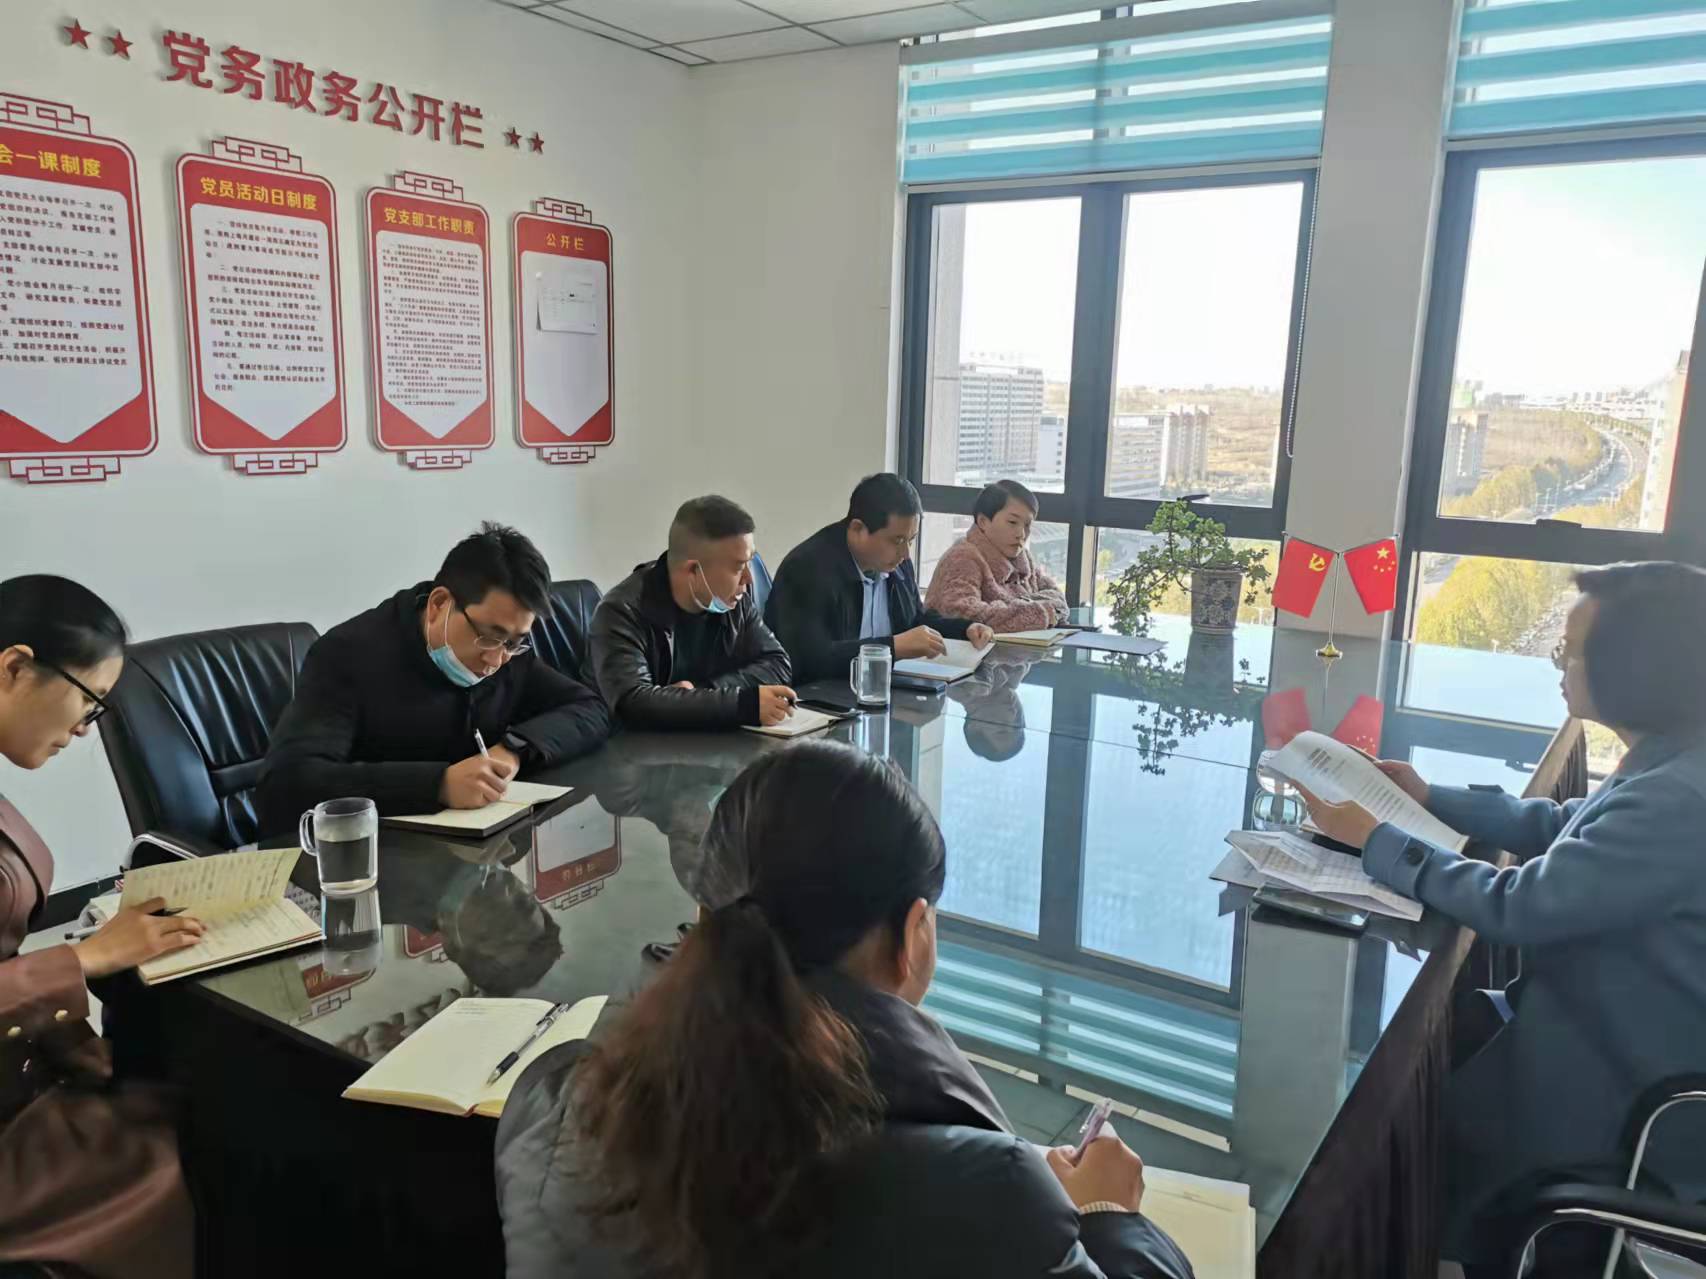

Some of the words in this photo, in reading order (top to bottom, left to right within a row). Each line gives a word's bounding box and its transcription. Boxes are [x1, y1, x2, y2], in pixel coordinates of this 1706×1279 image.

[163, 30, 484, 148] 党务政务公开栏
[0, 143, 101, 178] 会一课制度
[200, 177, 318, 211] 党员活动日制度
[384, 207, 475, 236] 党支部工作职责
[546, 232, 585, 251] 公开栏
